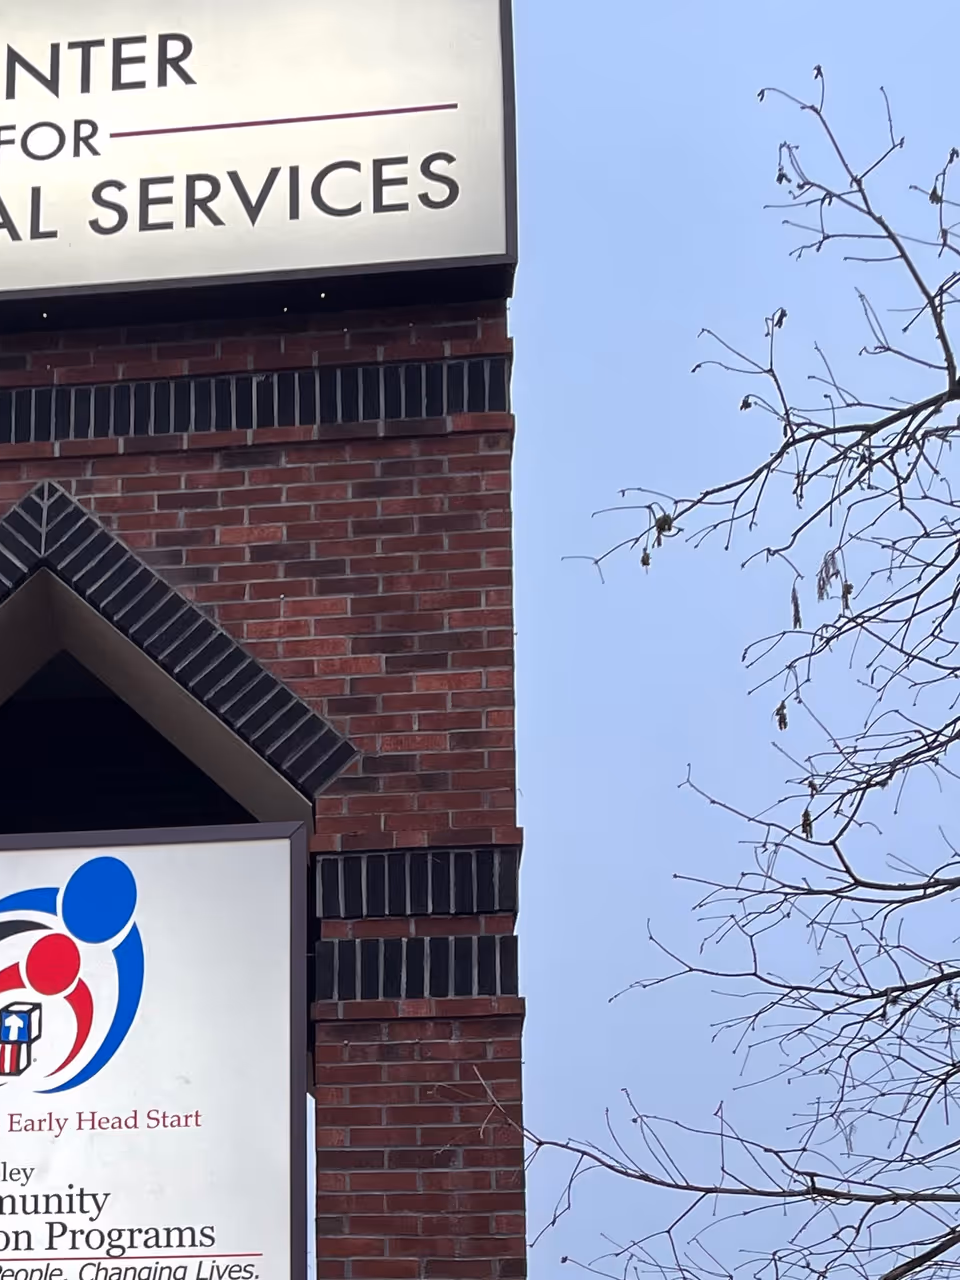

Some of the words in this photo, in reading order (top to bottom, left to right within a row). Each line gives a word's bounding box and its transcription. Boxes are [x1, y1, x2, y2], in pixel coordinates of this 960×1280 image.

[89, 152, 459, 235] SERVICES
[8, 1112, 68, 1138] Early
[76, 1110, 139, 1130] Head
[147, 1109, 201, 1128] Start
[45, 1220, 215, 1258] Programs
[193, 1256, 259, 1280] Lives.
